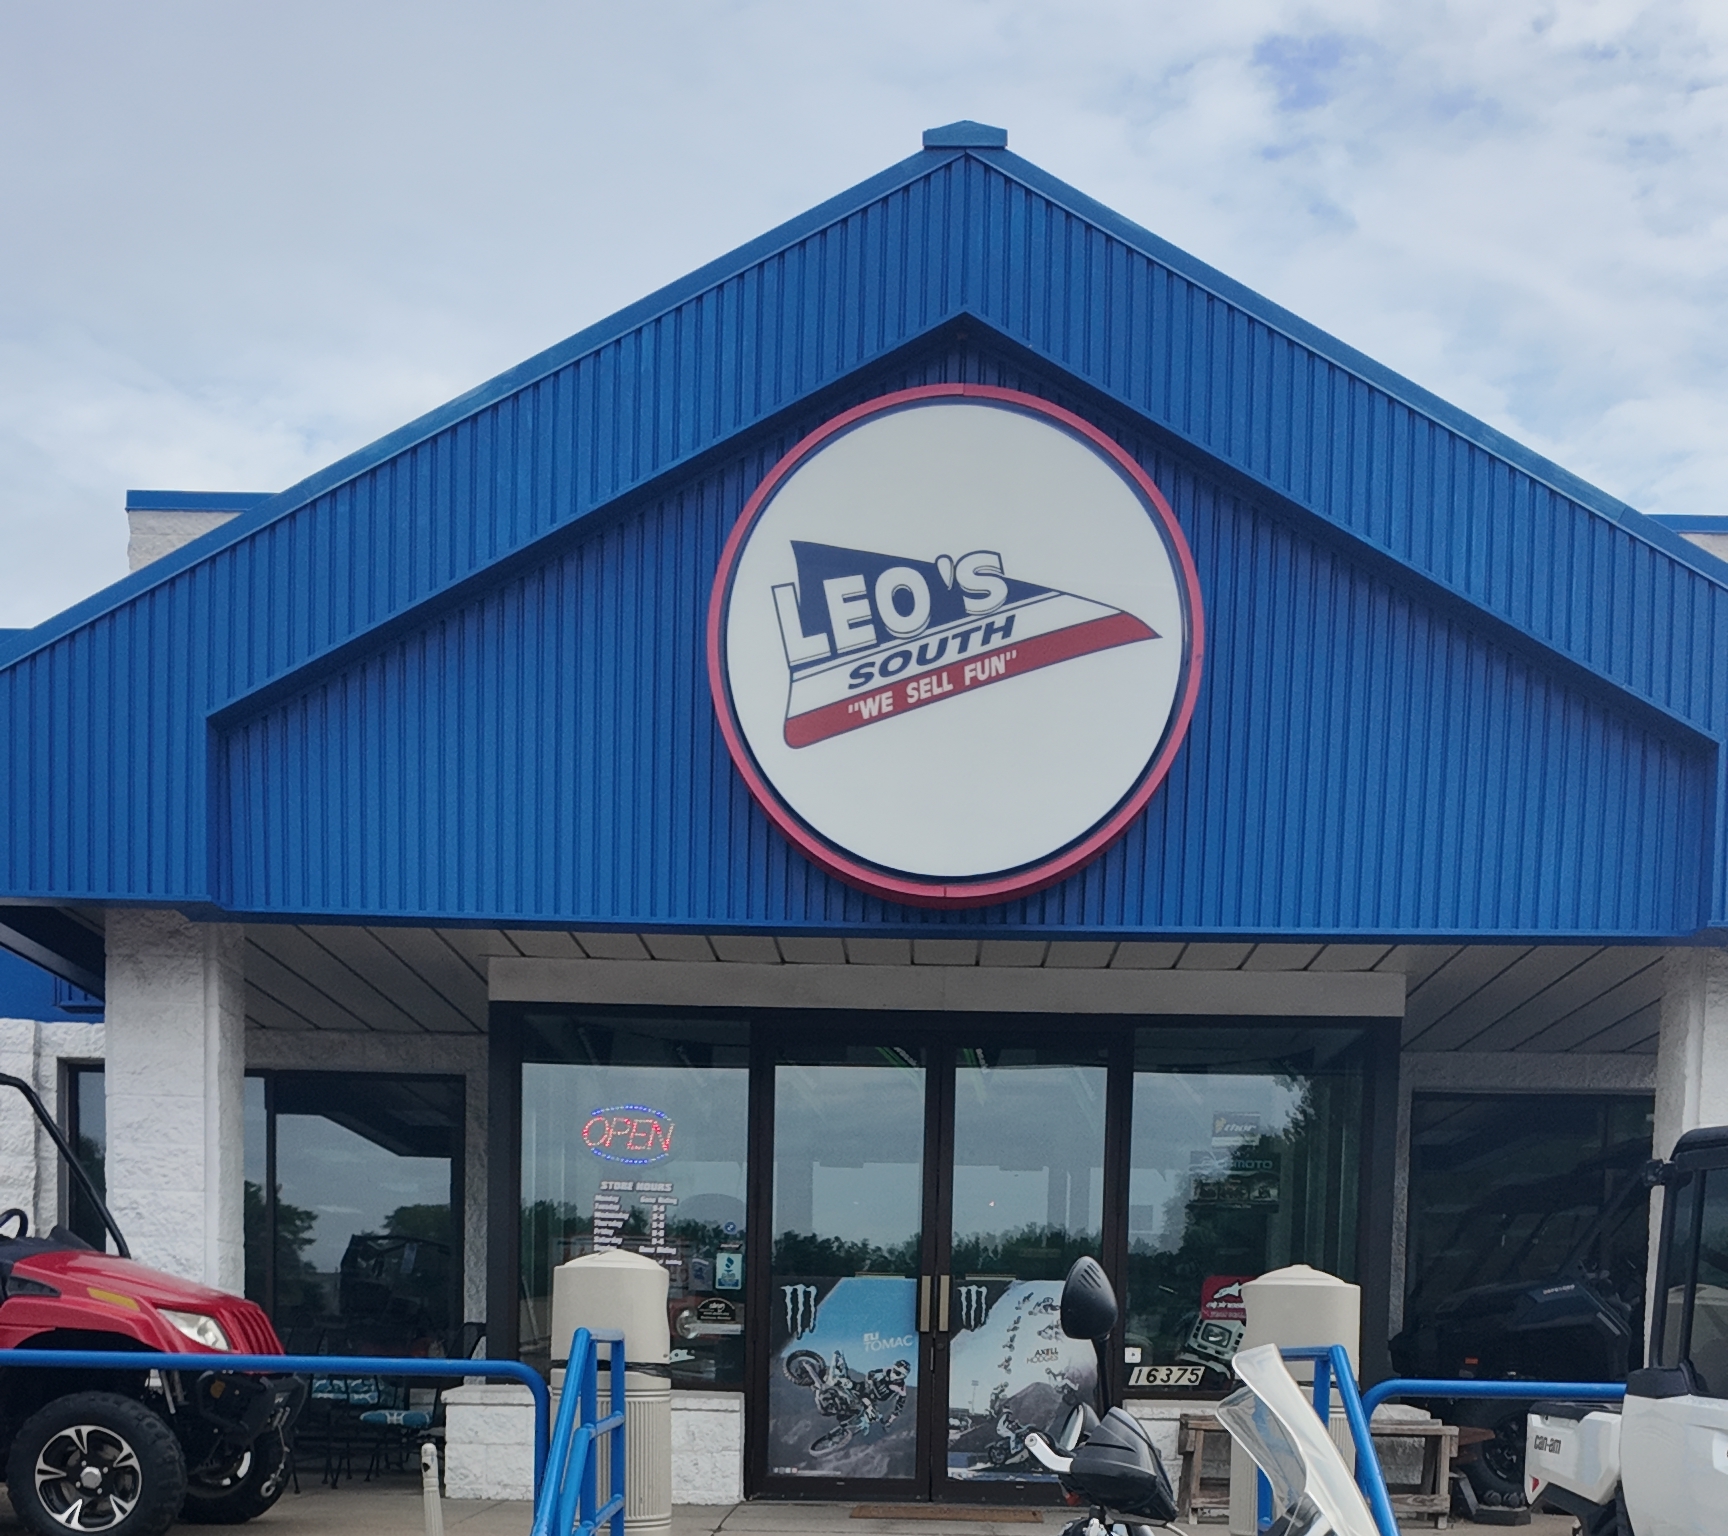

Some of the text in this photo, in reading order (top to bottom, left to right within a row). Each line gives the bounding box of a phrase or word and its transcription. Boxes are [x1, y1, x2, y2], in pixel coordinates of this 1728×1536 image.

[771, 550, 1008, 670] LEO'S
[847, 614, 1016, 690] SOUTH
[848, 649, 1017, 720] "WE SELL FUN"
[582, 1116, 674, 1151] OPEN
[600, 1181, 673, 1192] STORE HOURS
[863, 1332, 880, 1342] ELI
[863, 1334, 914, 1352] TOMAC
[1134, 1367, 1202, 1385] 16375
[1533, 1434, 1562, 1455] can-am
